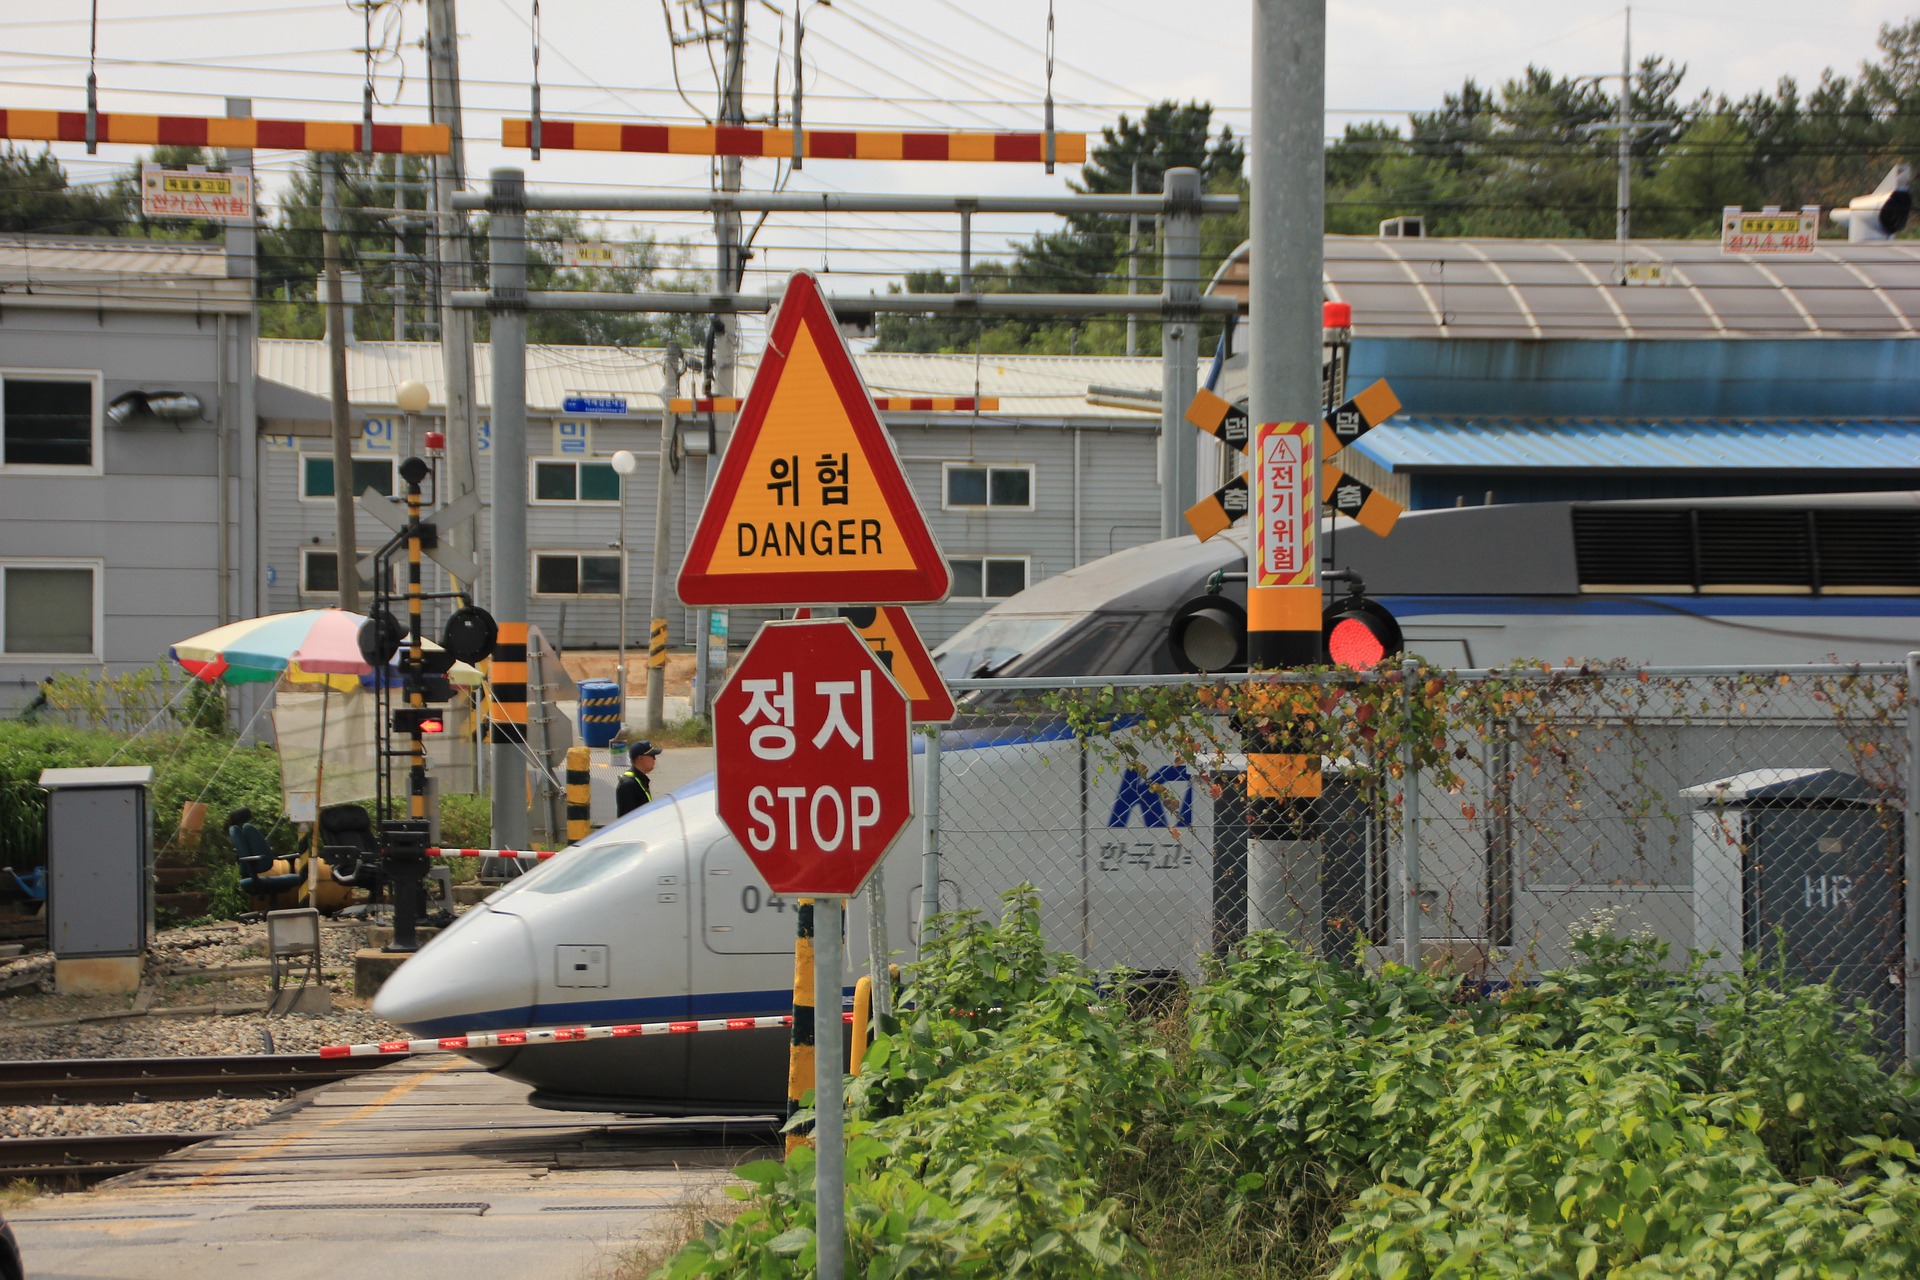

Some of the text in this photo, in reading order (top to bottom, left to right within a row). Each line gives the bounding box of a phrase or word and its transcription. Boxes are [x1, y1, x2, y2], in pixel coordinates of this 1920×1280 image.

[152, 194, 243, 213] 전기 위험
[767, 453, 848, 506] 위험
[738, 519, 882, 556] DANGER
[738, 669, 873, 760] 정지
[747, 785, 880, 851] STOP
[1805, 875, 1853, 908] HR
